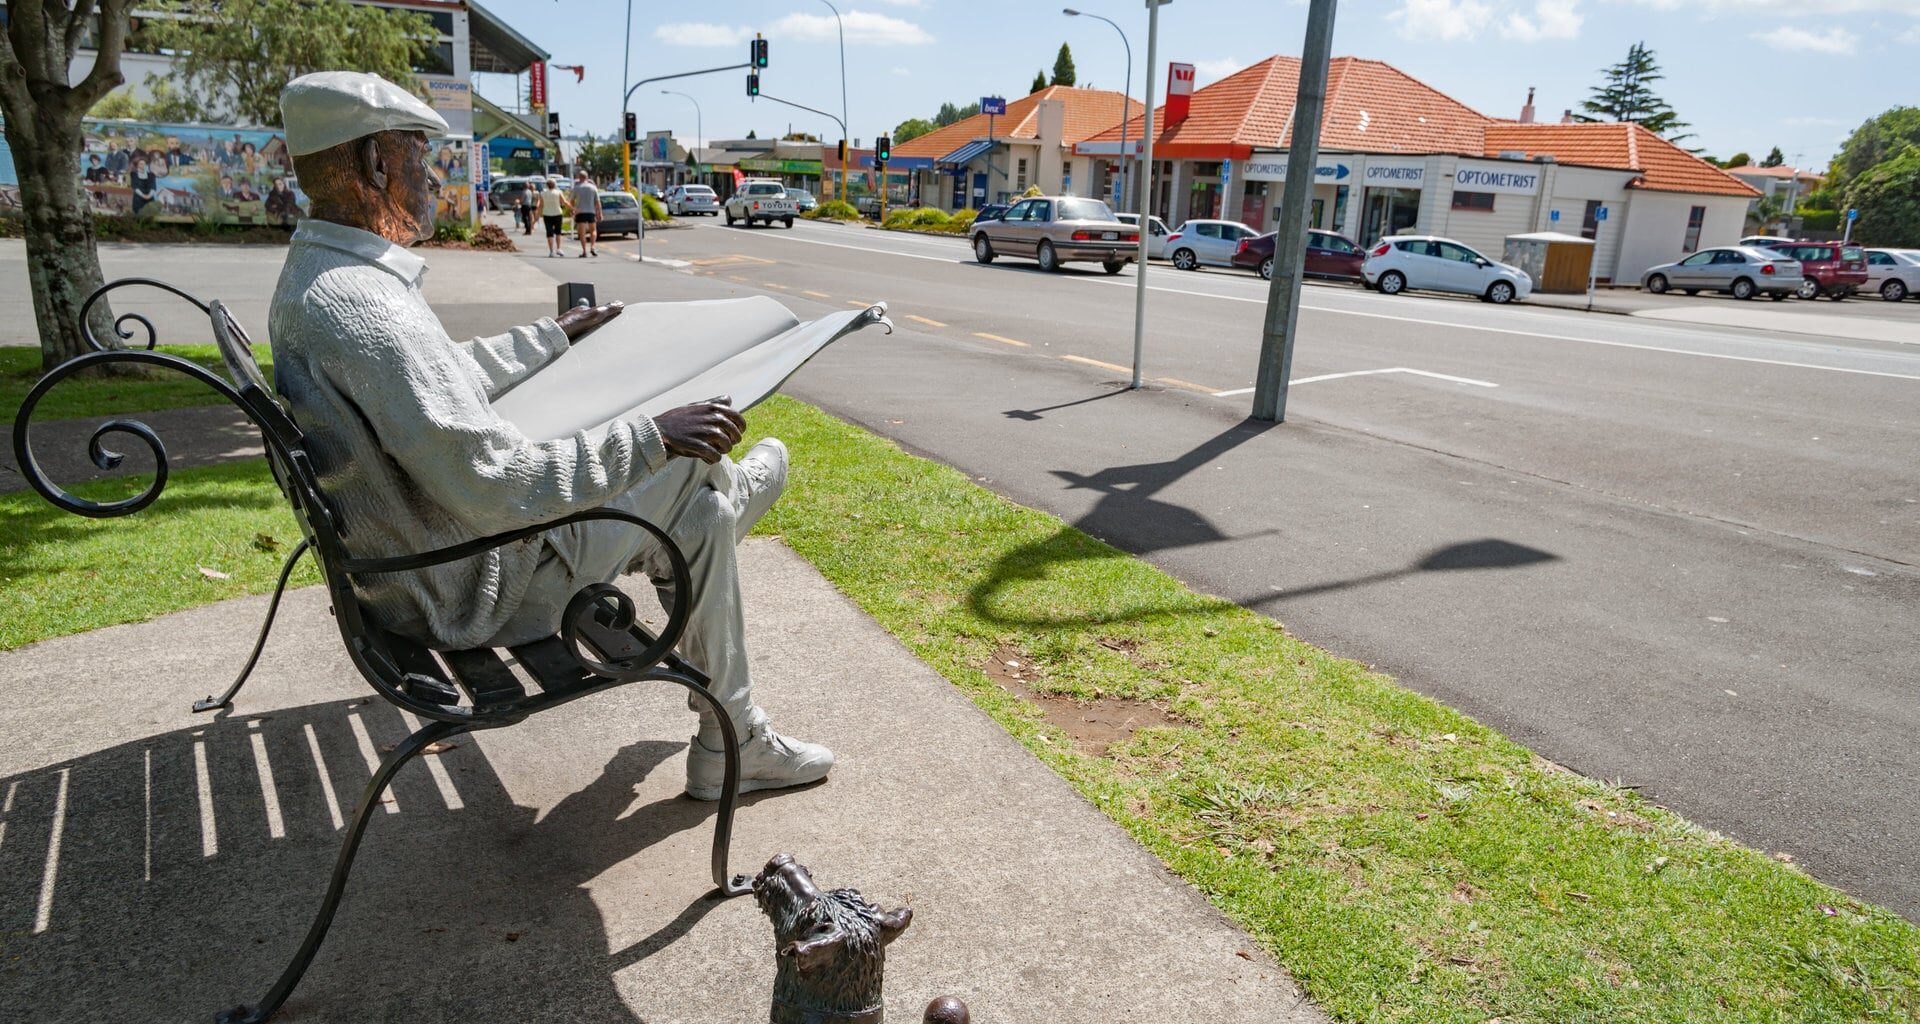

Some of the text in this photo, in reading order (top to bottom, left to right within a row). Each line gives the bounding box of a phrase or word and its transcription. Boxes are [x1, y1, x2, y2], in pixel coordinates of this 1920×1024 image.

[429, 82, 468, 91] BODYWORK
[984, 103, 999, 113] bnz
[514, 150, 532, 158] ANZ
[1244, 163, 1288, 175] OPTOMETRIST
[1366, 166, 1424, 181] OPTOMETRIST
[1457, 169, 1537, 189] OPTOMETRIST
